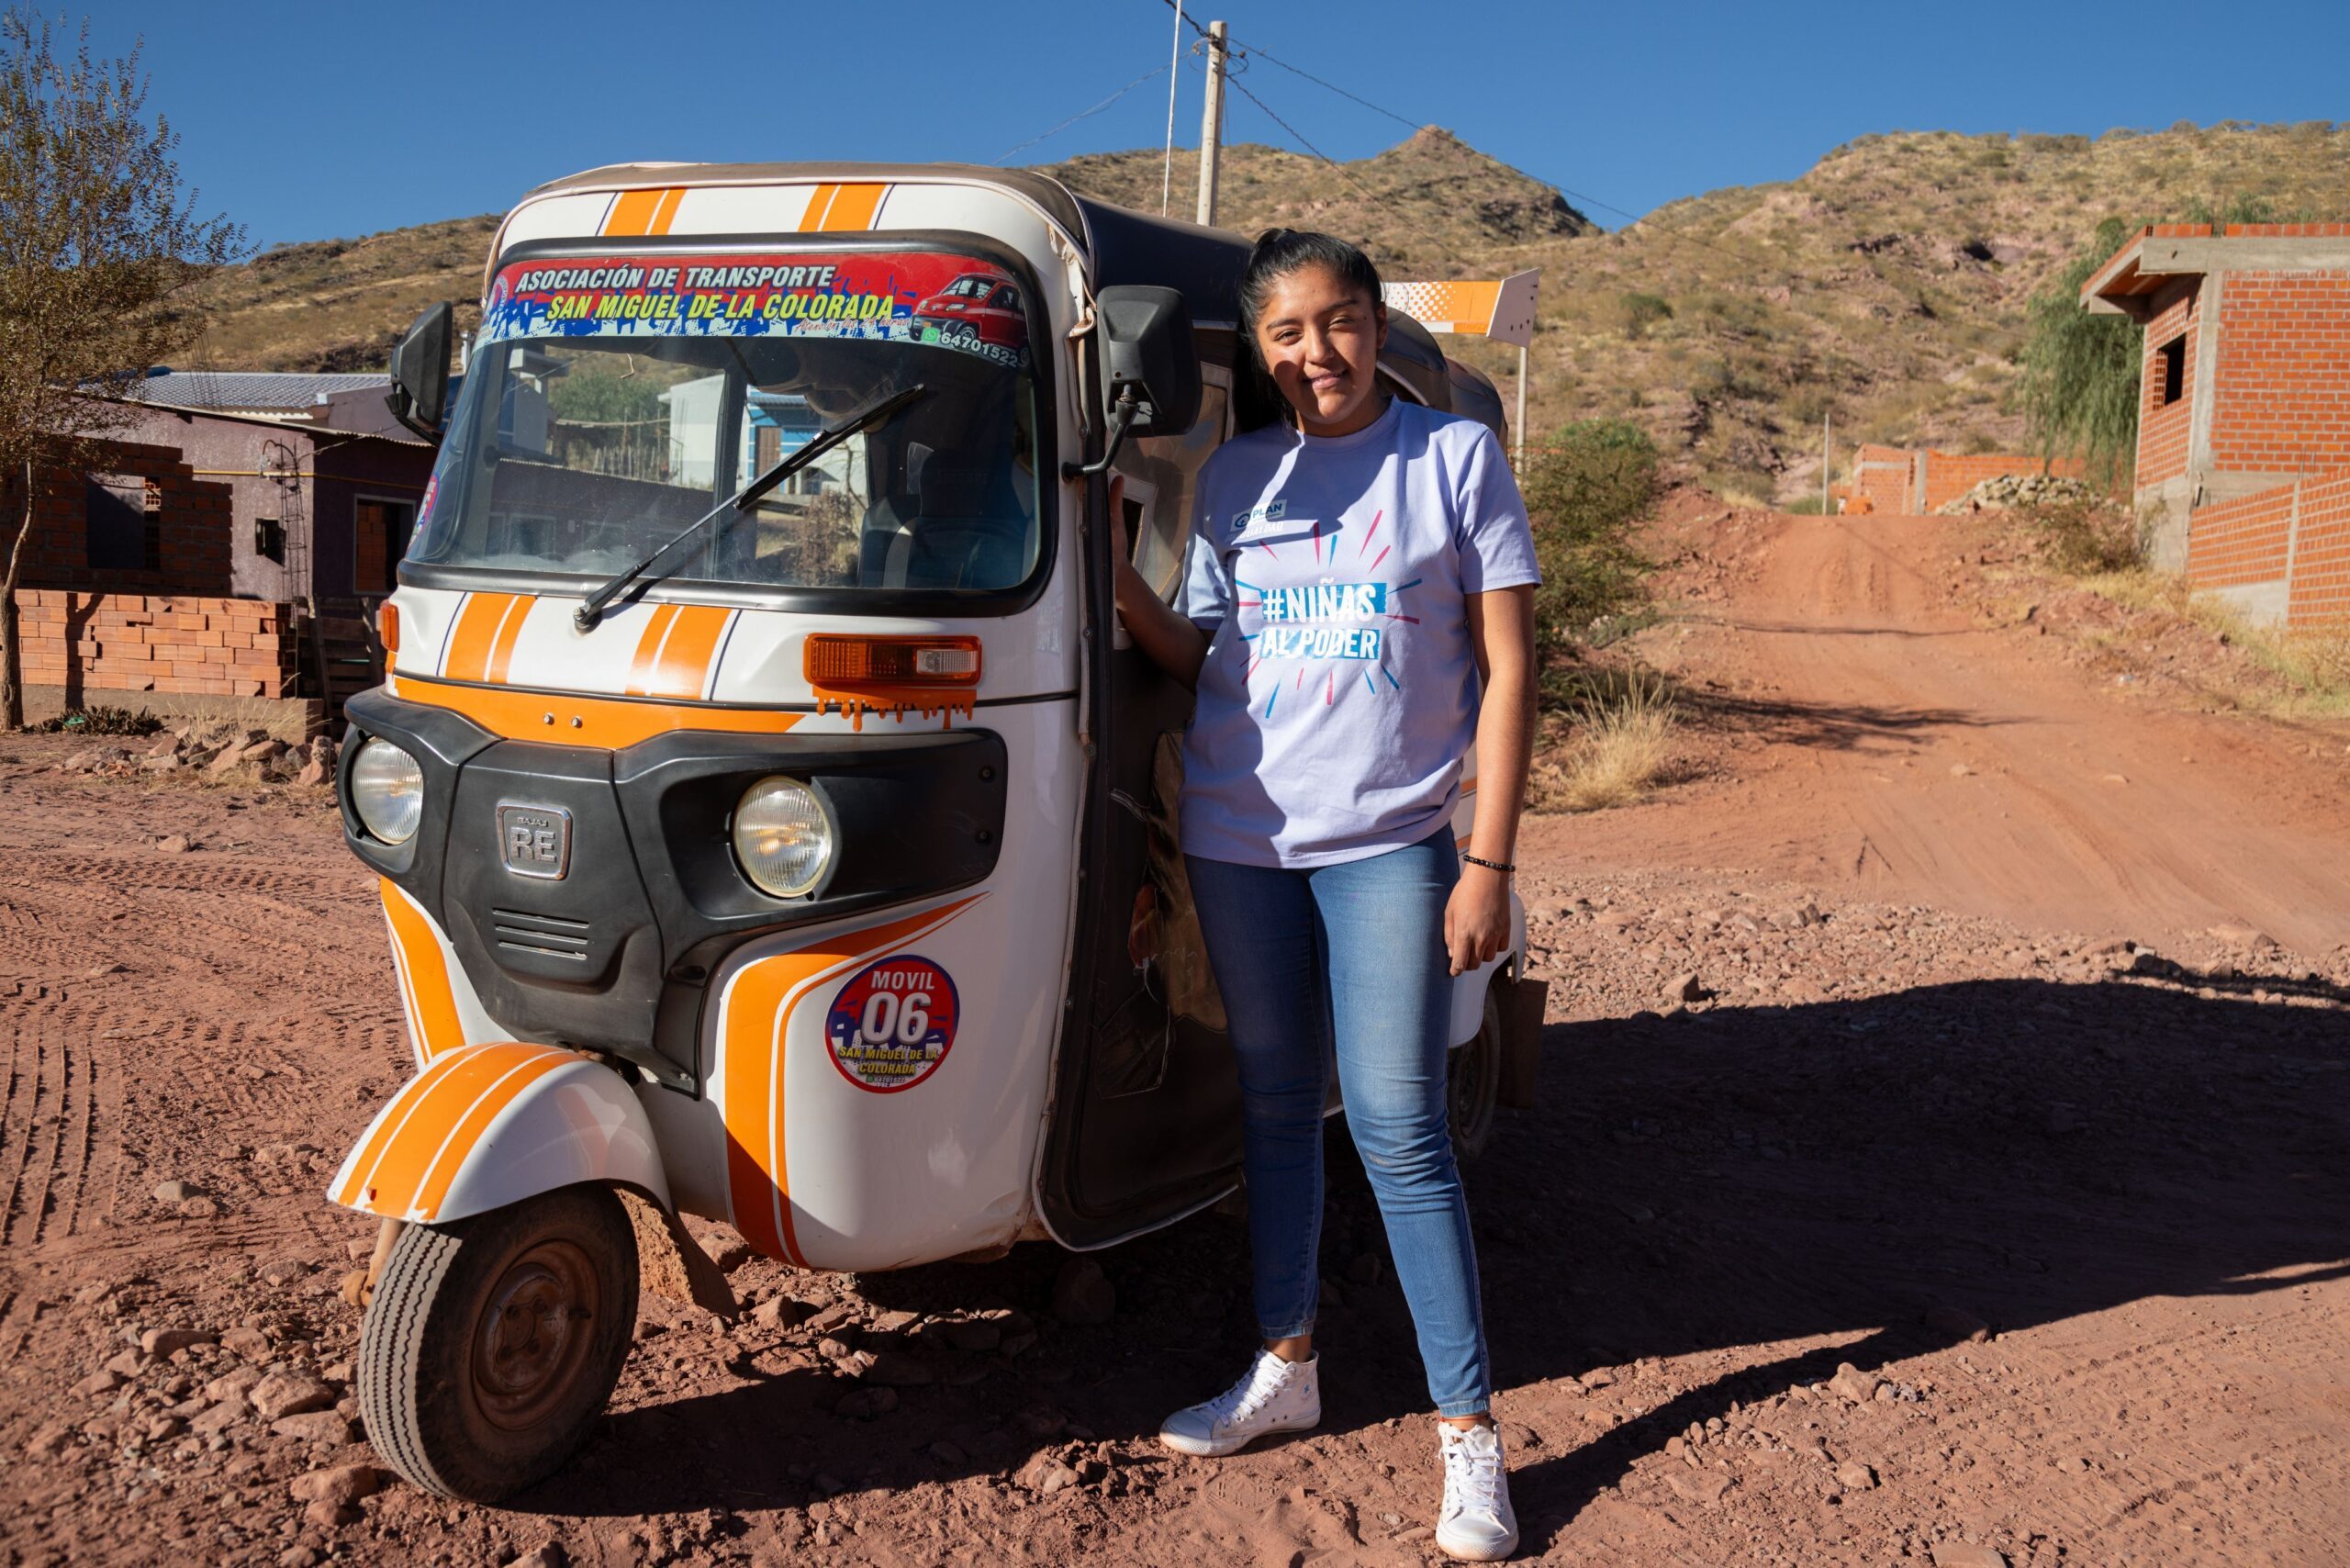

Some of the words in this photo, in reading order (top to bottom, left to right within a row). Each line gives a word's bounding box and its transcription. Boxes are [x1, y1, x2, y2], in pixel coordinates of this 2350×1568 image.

[515, 264, 643, 293] ASOCIACIÓN
[648, 268, 679, 288] DE
[685, 266, 835, 288] TRANSPORTE
[546, 296, 592, 319] SAN
[597, 295, 680, 319] MIGUEL
[687, 295, 720, 319] DE
[724, 295, 757, 319] LA
[763, 294, 894, 319] COLORADA
[941, 332, 1018, 367] 64701522
[1253, 504, 1282, 518] PLAN
[1263, 577, 1376, 623] #NIÑAS
[1261, 627, 1290, 658] AL
[1297, 628, 1377, 658] PODER
[518, 817, 549, 827] BAJAJ
[510, 826, 557, 863] RE
[871, 970, 935, 990] MOVIL
[860, 991, 932, 1045] 06
[839, 1047, 861, 1058] SAN
[865, 1049, 906, 1060] MIGUEL
[910, 1049, 923, 1060] DE
[925, 1049, 937, 1060] LA
[858, 1063, 916, 1074] COLORADA
